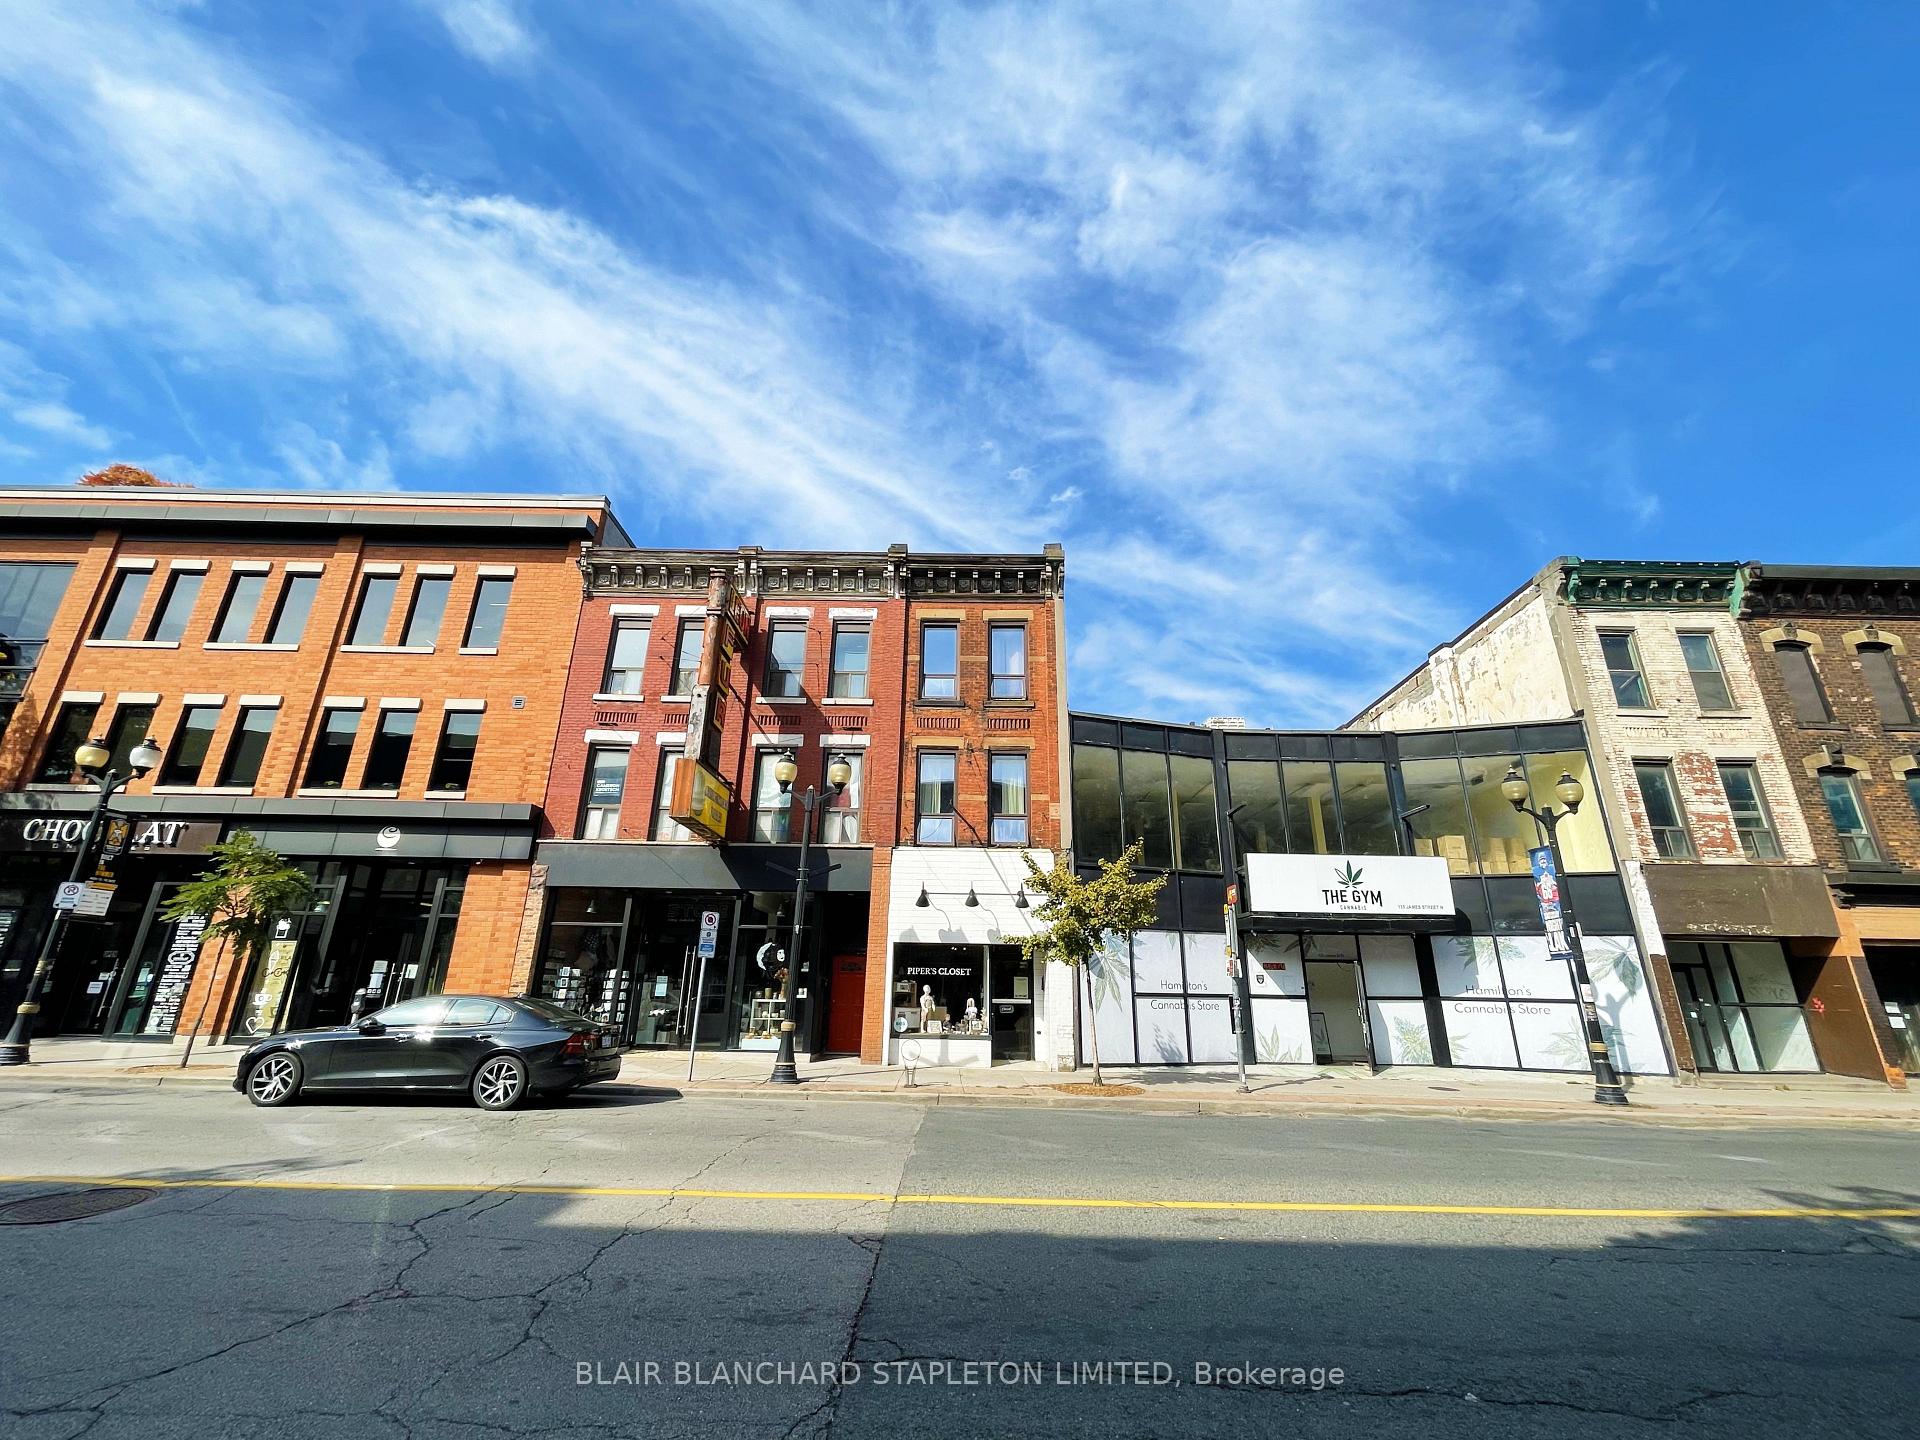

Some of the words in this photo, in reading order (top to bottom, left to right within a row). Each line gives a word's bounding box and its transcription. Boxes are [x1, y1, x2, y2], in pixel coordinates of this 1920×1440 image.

[23, 819, 187, 845] CHOCAT
[1322, 889, 1348, 905] THE
[1352, 890, 1383, 907] GYM
[907, 967, 937, 975] PIPER'S
[938, 967, 971, 976] CLOSET
[1161, 979, 1208, 991] Hamton's
[1465, 985, 1532, 996] Hamilon's
[1197, 1000, 1220, 1011] Store
[1454, 1003, 1516, 1014] Cannabis
[1518, 1003, 1551, 1015] Store
